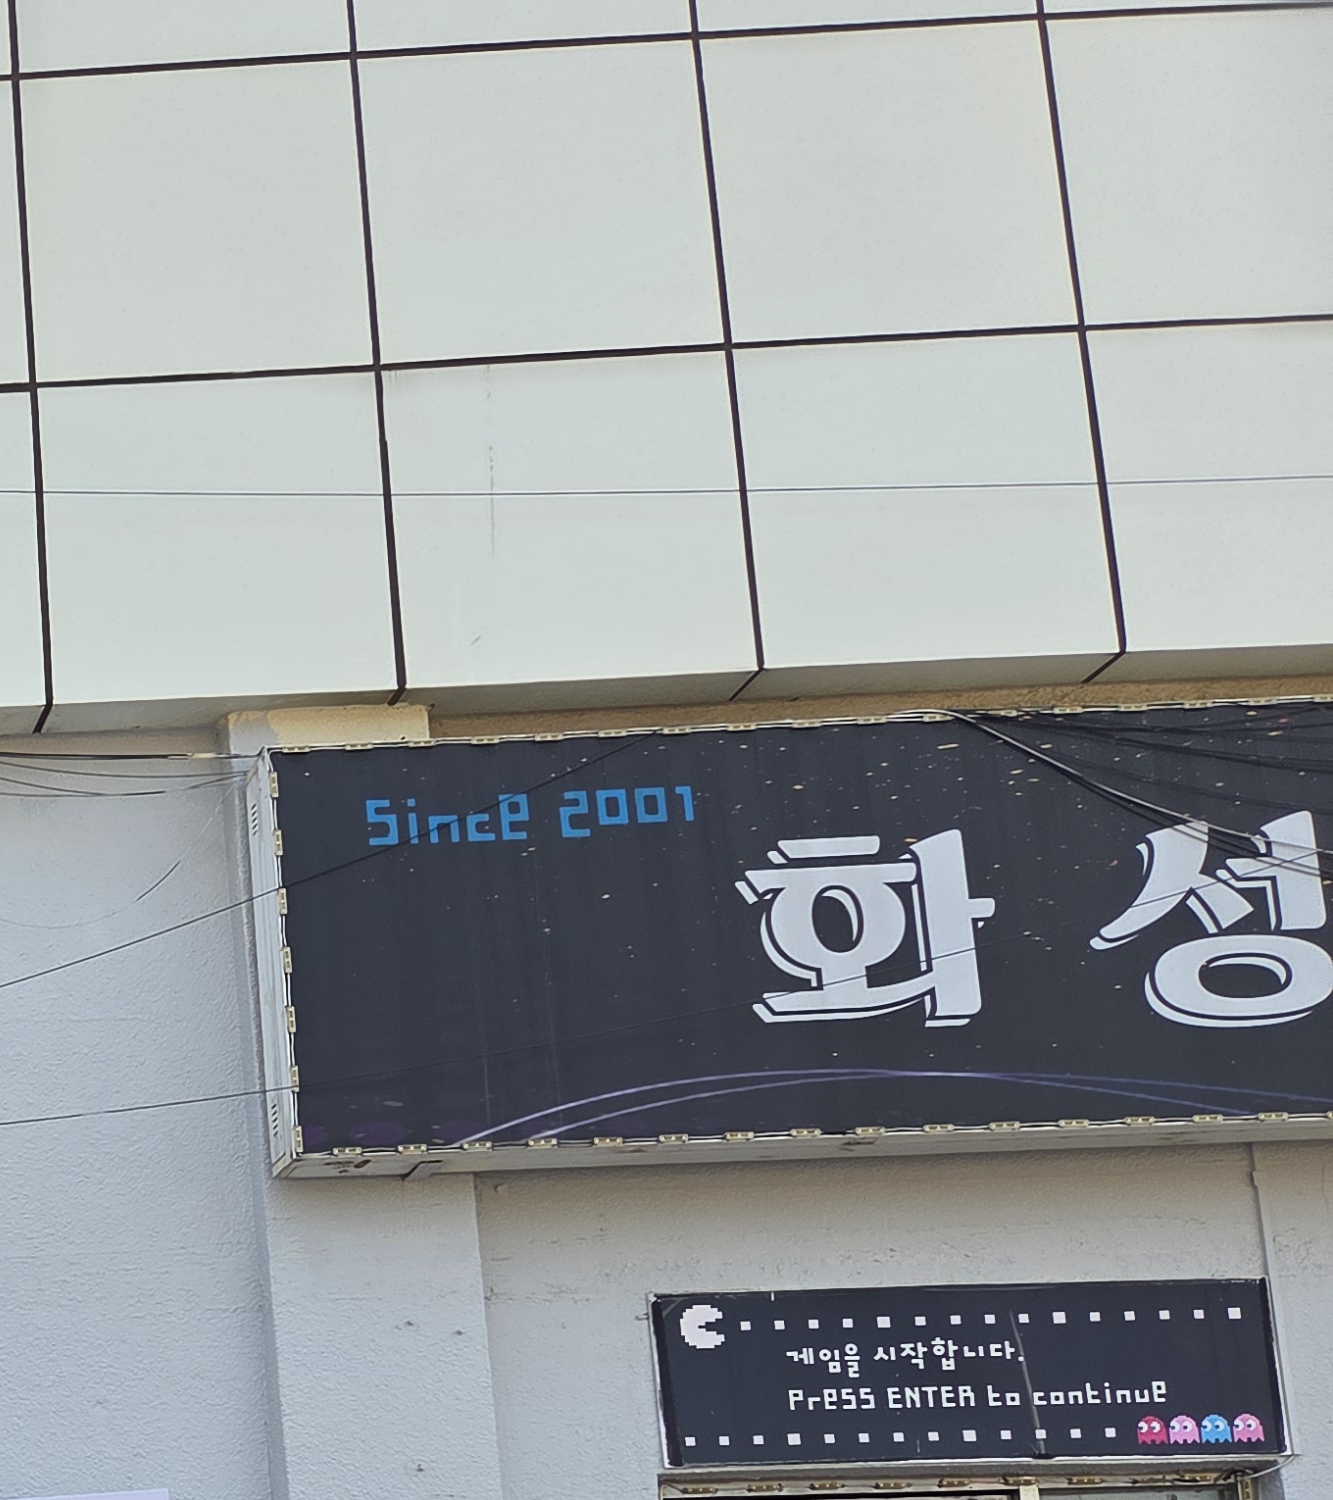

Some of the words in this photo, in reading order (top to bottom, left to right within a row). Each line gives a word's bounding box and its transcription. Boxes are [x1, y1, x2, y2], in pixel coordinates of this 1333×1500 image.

[365, 793, 530, 846] Since
[560, 785, 696, 839] 2001
[785, 1347, 861, 1378] 게임을
[873, 1337, 1026, 1372] 시작합니다.
[887, 1385, 976, 1409] ENTER
[986, 1383, 1021, 1407] to
[1032, 1379, 1168, 1406] continue
